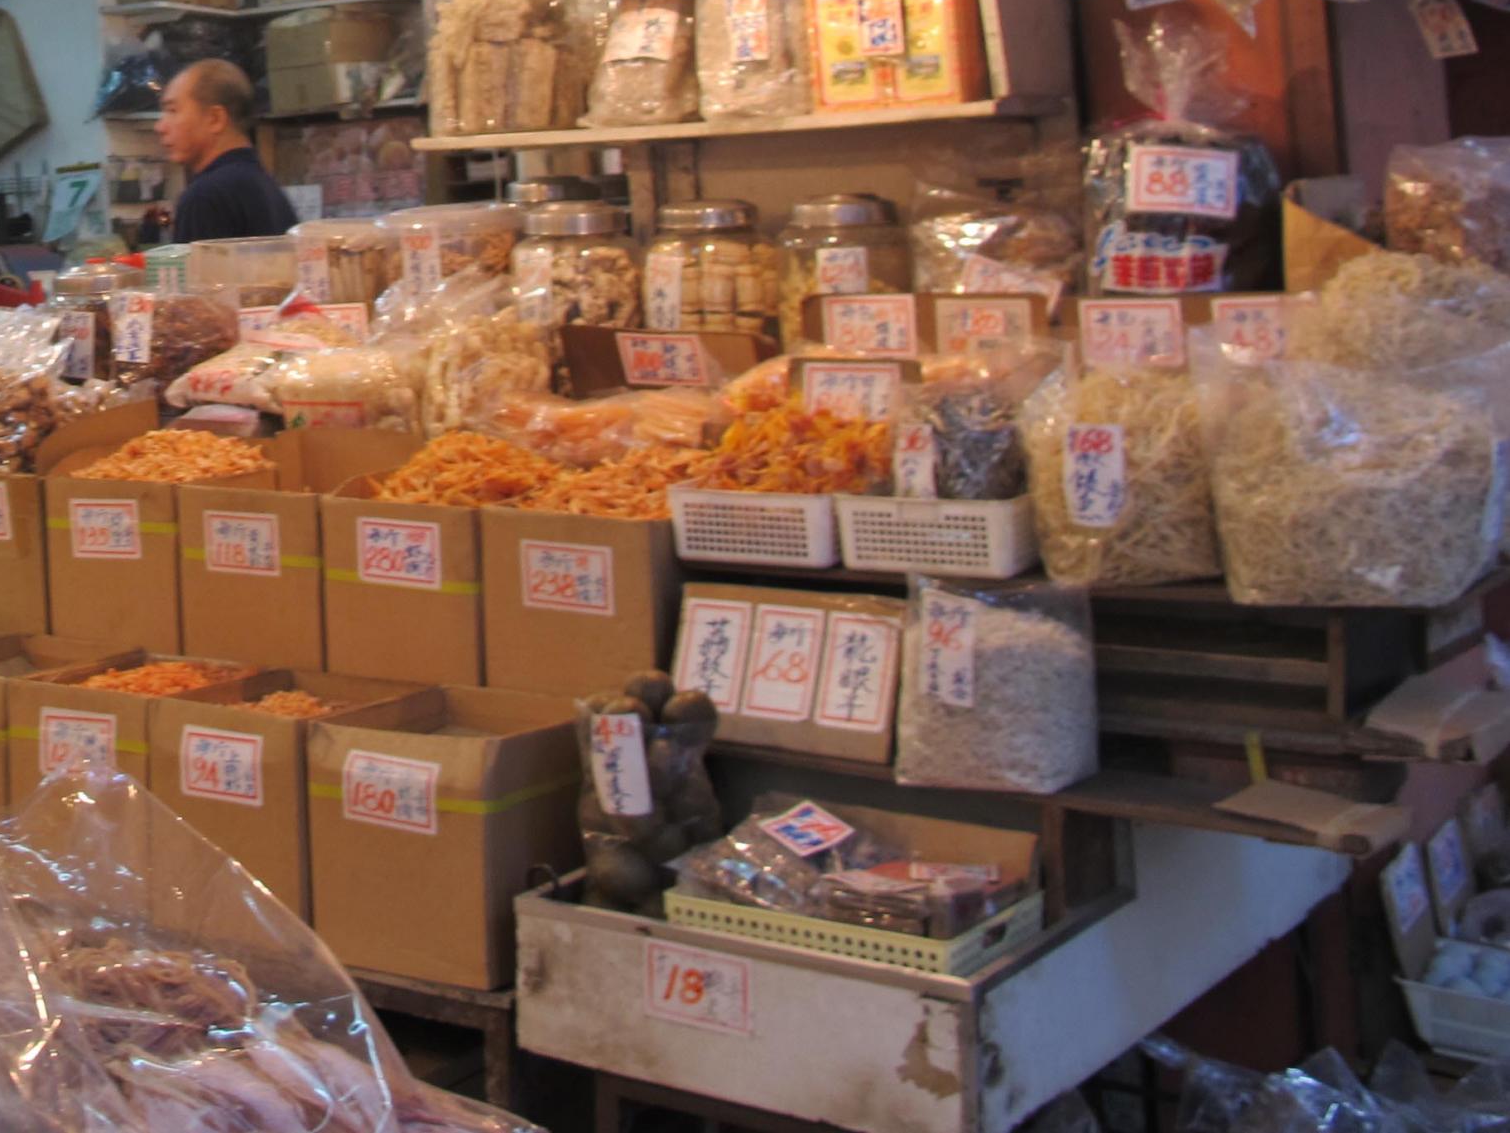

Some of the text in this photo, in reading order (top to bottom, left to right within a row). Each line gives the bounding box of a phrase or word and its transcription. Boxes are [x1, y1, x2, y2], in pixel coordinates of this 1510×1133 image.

[69, 181, 89, 207] 7
[1146, 171, 1189, 196] 88
[752, 649, 811, 684] 68
[352, 780, 396, 815] 180
[664, 963, 704, 1006] 18
